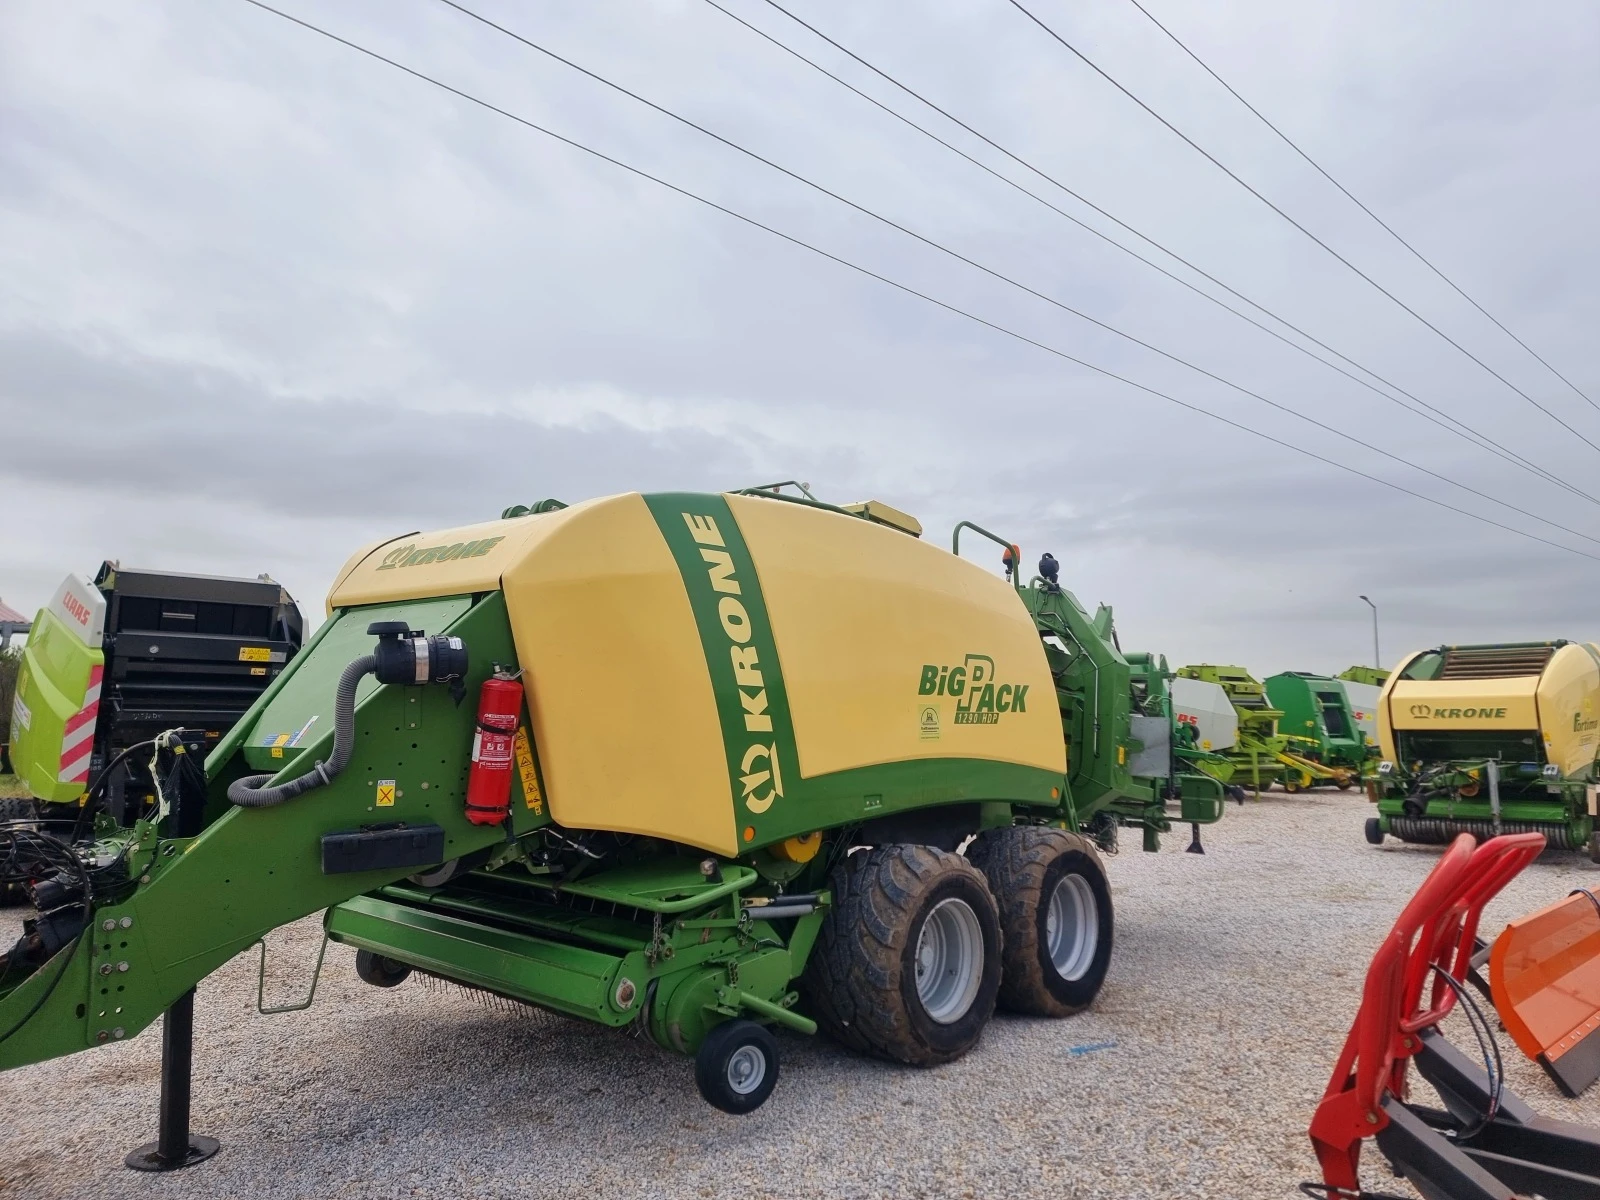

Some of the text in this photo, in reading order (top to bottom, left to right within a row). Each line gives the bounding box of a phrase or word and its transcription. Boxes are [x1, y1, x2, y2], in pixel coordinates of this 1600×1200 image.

[399, 536, 506, 568] KRONE
[62, 591, 91, 626] CLAAS
[681, 512, 773, 732] KRONE
[956, 654, 1029, 712] PACK
[958, 713, 998, 724] 1290 HDP
[1433, 707, 1508, 719] KRONE
